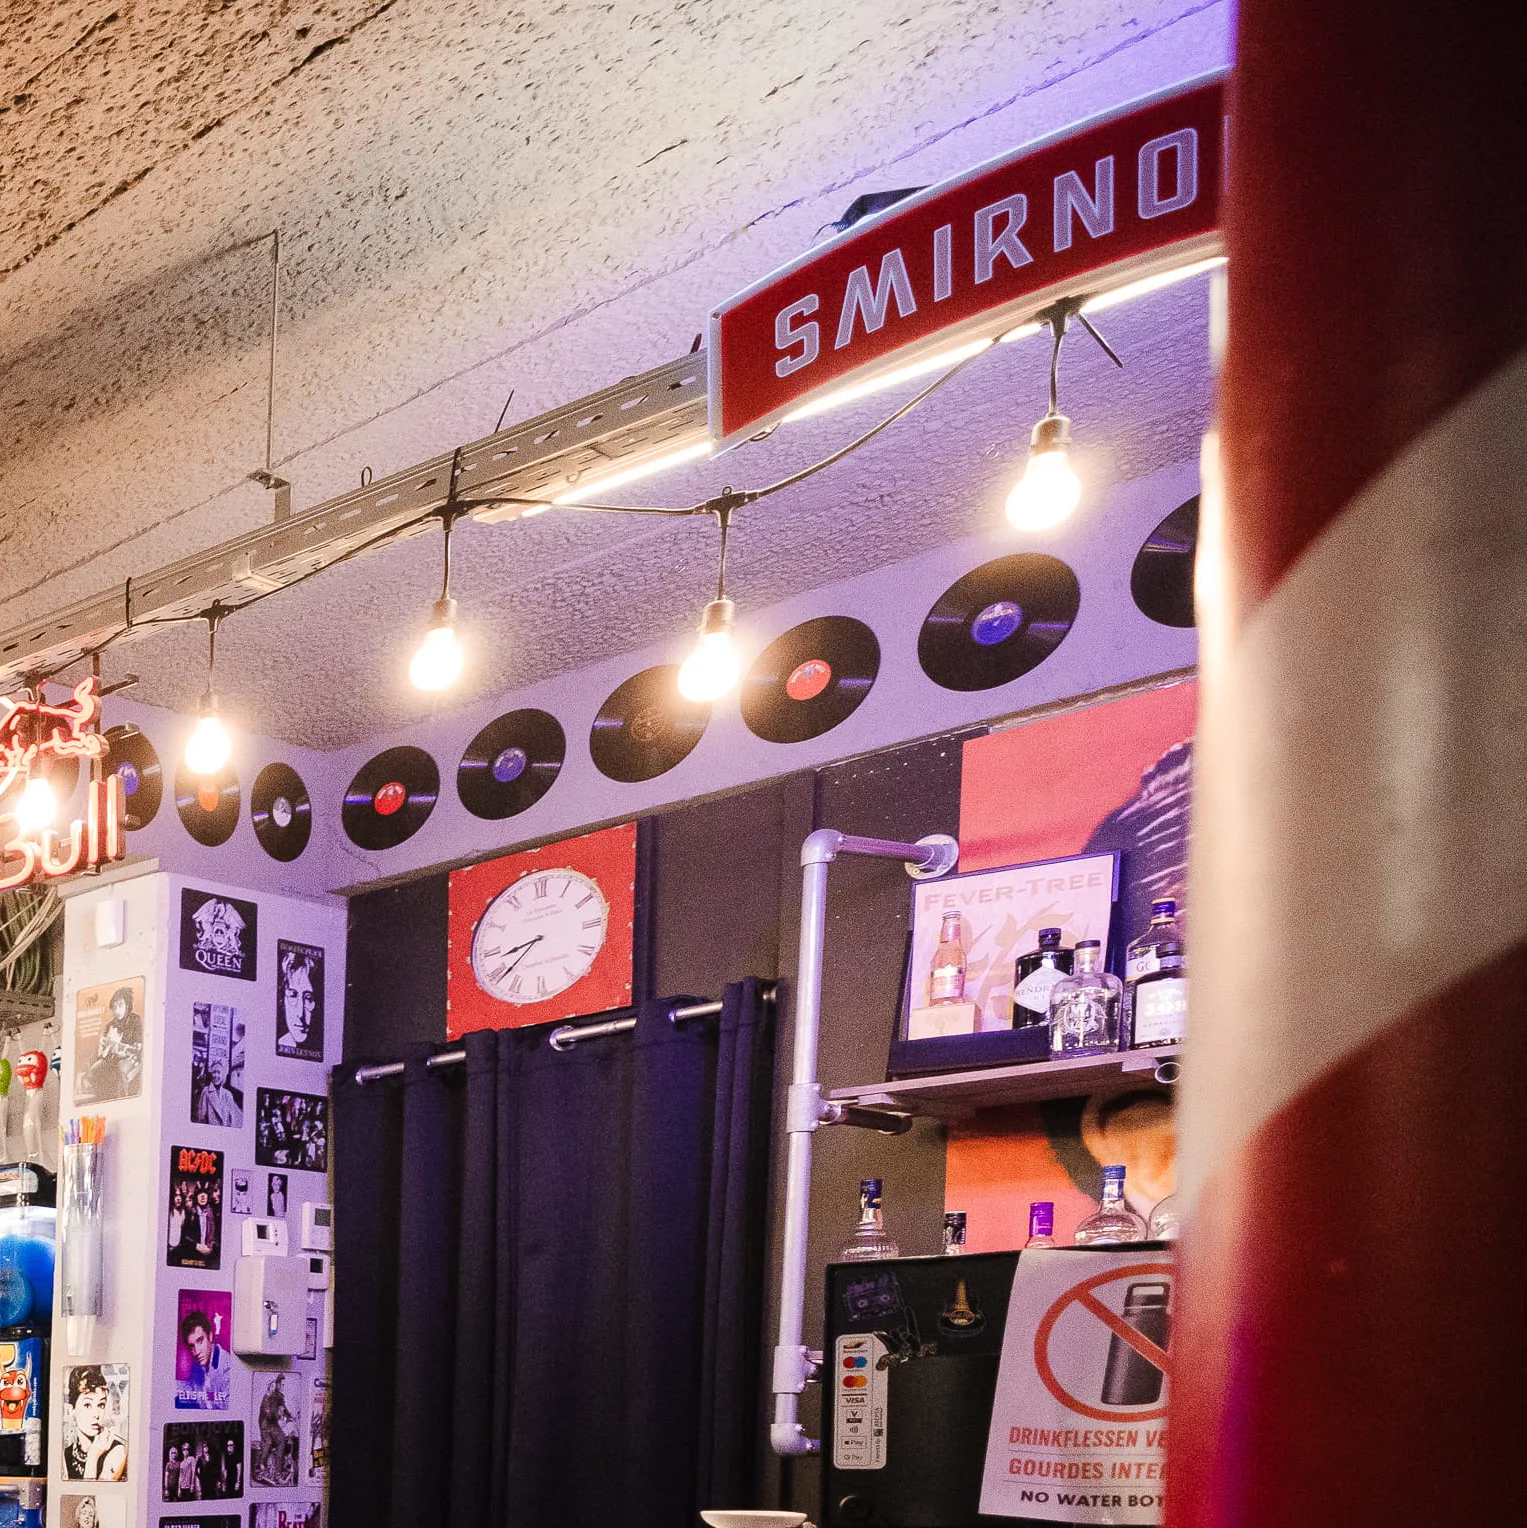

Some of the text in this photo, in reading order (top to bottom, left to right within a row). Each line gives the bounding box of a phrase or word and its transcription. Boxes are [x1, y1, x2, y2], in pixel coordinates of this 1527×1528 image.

[775, 128, 1198, 378] SMIRNO
[924, 872, 1103, 912] FEVER-TREE
[195, 949, 243, 972] QUEEN
[178, 1148, 217, 1174] AC/DC
[1009, 1426, 1139, 1448] DRINKFLESSEN
[1009, 1458, 1104, 1479] GOURDES
[1021, 1490, 1049, 1502] NO
[1057, 1493, 1122, 1507] WATER
